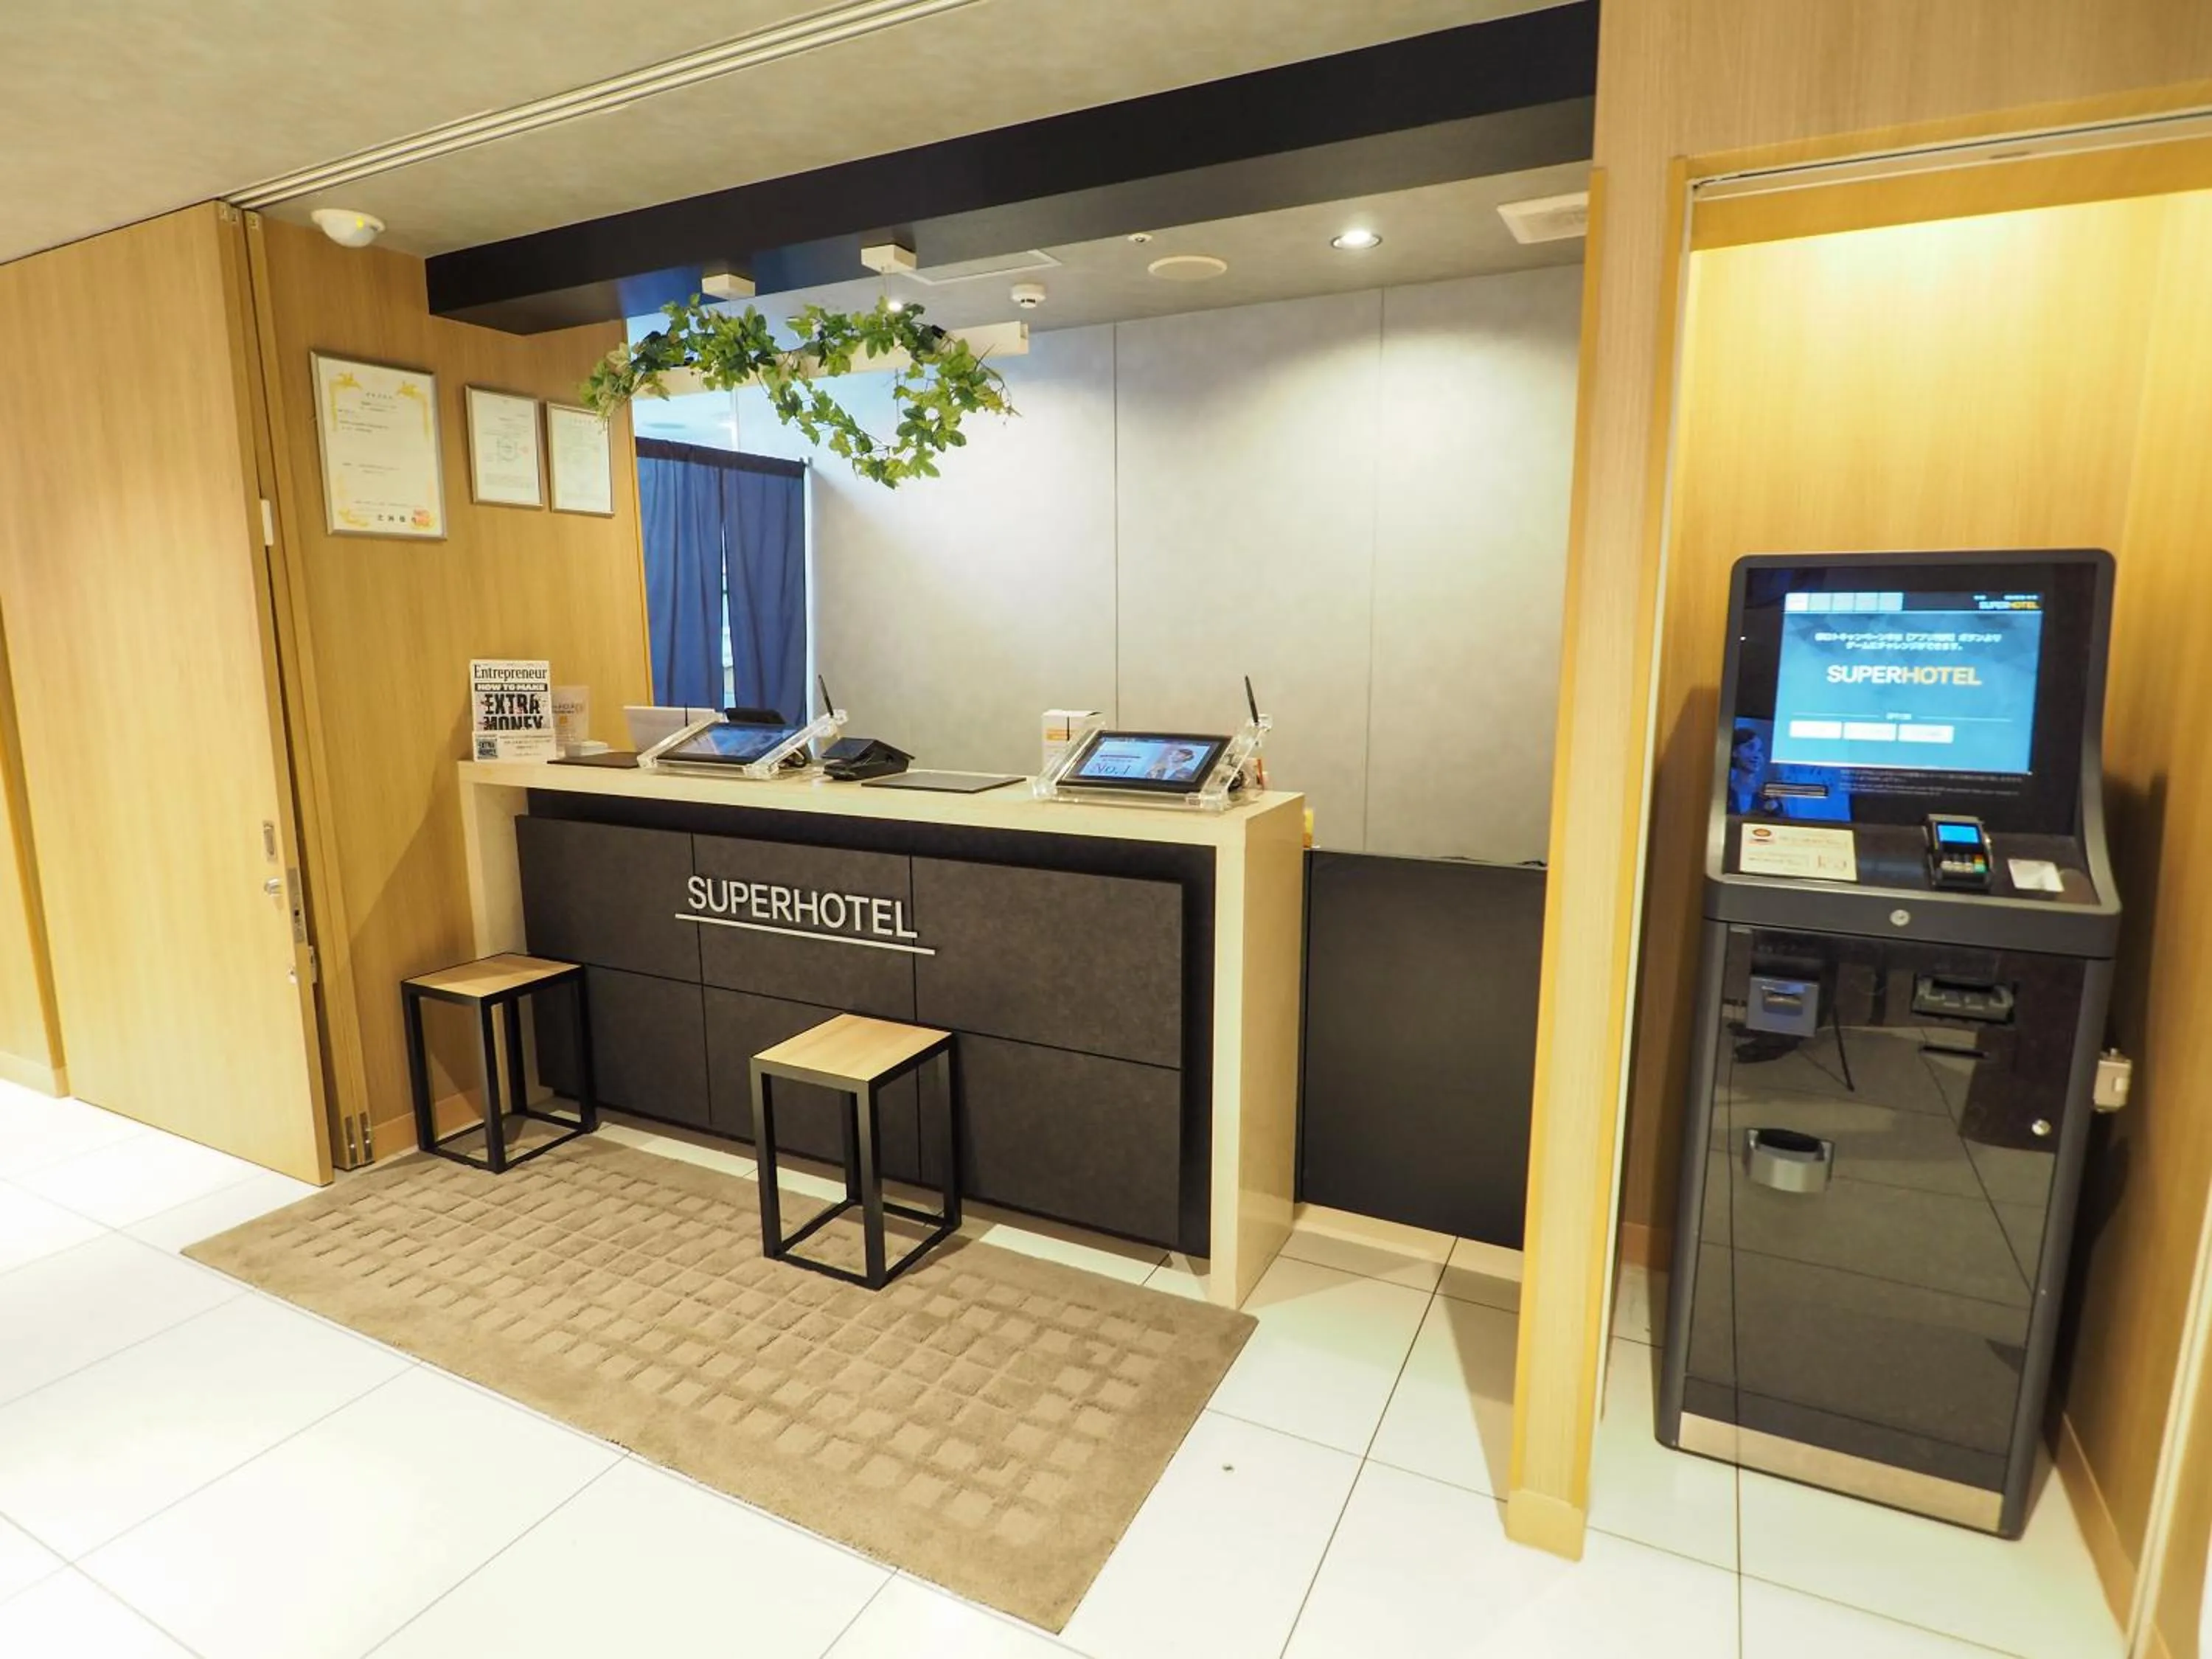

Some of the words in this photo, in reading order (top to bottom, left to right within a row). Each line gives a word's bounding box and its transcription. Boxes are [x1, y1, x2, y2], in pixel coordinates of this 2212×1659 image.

[474, 664, 547, 682] Entrepreneur
[1826, 664, 1983, 686] SUPERHOTEL
[484, 694, 540, 714] EXTRA
[687, 875, 919, 939] SUPERHOTEL
